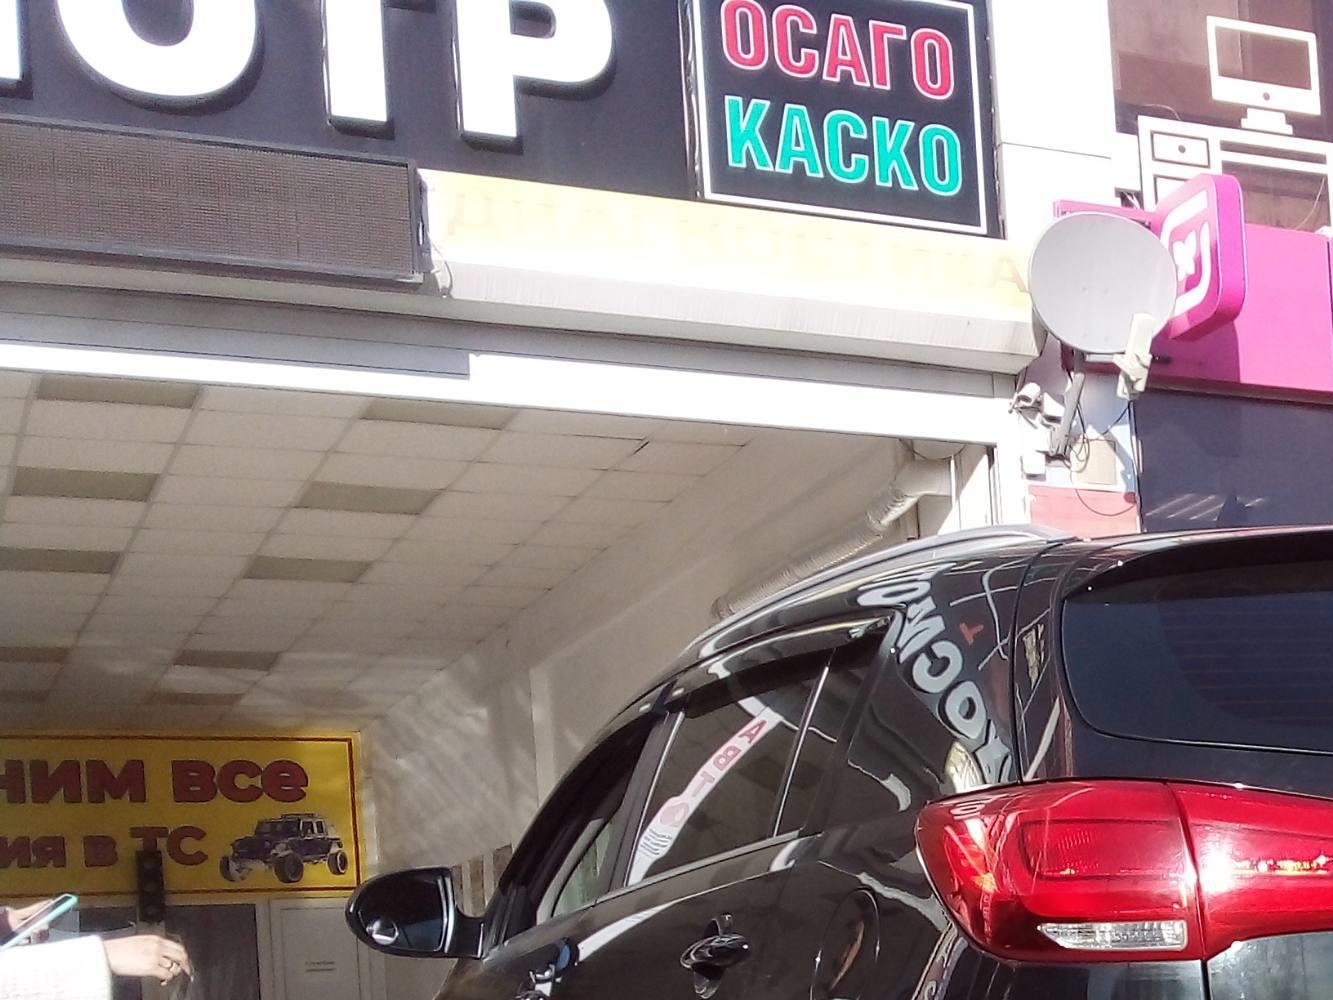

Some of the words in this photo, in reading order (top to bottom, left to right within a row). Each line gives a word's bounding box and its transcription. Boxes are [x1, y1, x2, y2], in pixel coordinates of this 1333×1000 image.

[721, 0, 954, 99] ОСАГО
[725, 95, 961, 196] КАСКО
[172, 759, 309, 803] все
[83, 835, 118, 868] в
[130, 826, 208, 866] ТС
